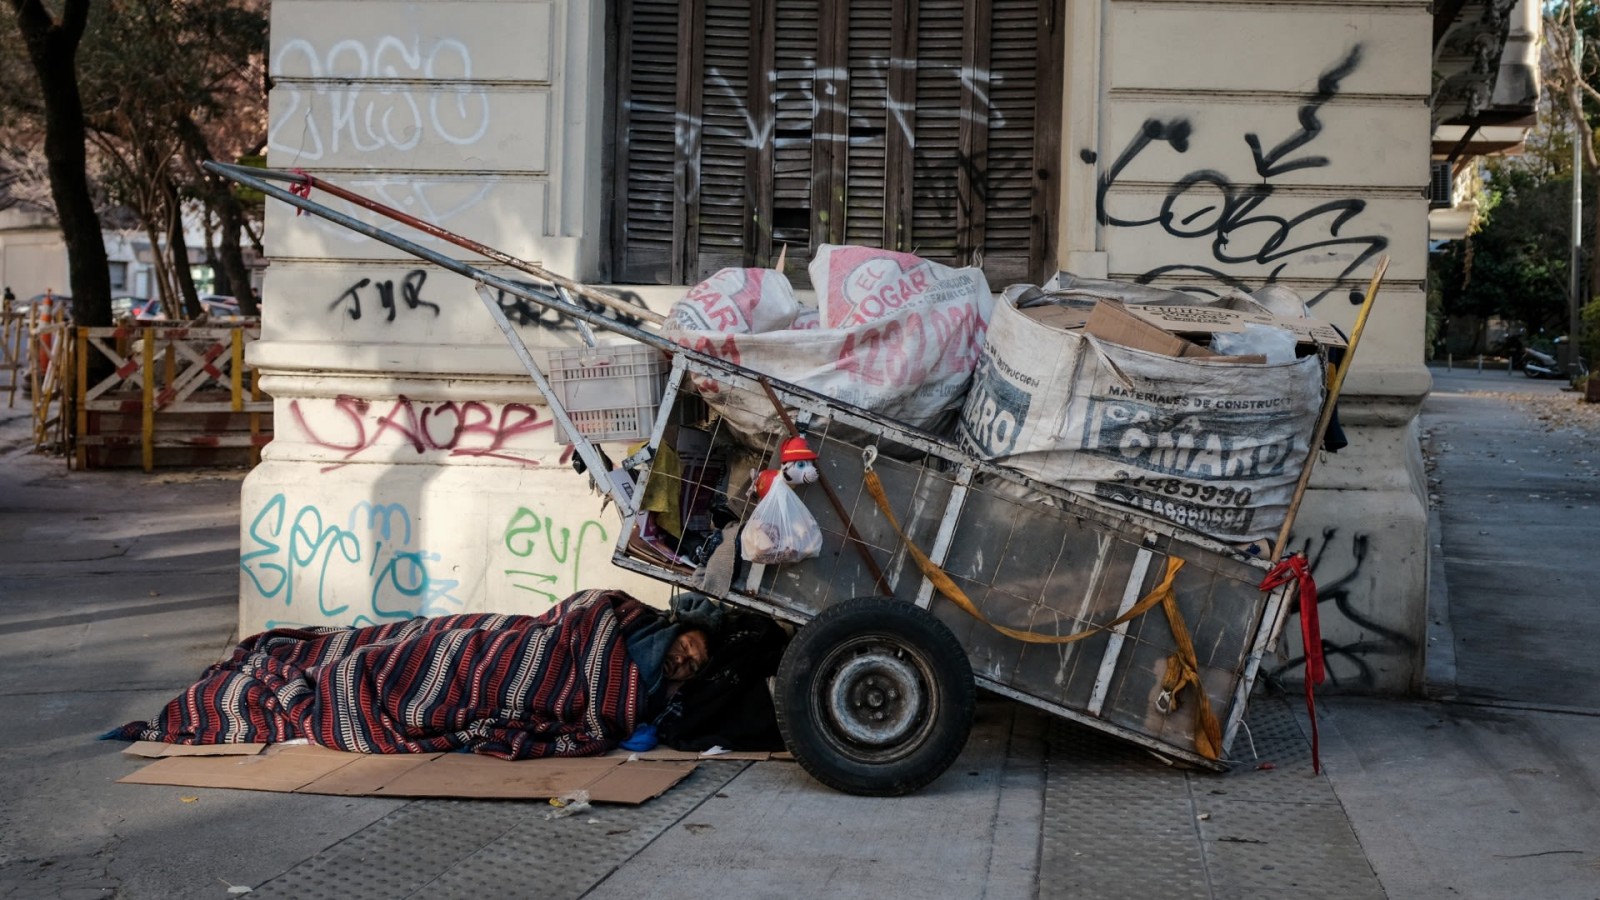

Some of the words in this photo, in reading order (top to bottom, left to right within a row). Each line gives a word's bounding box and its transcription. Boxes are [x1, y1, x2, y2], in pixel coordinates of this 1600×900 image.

[996, 354, 1041, 389] NSTRUCCION
[1109, 385, 1190, 408] MATERIALES
[1193, 398, 1211, 409] DE
